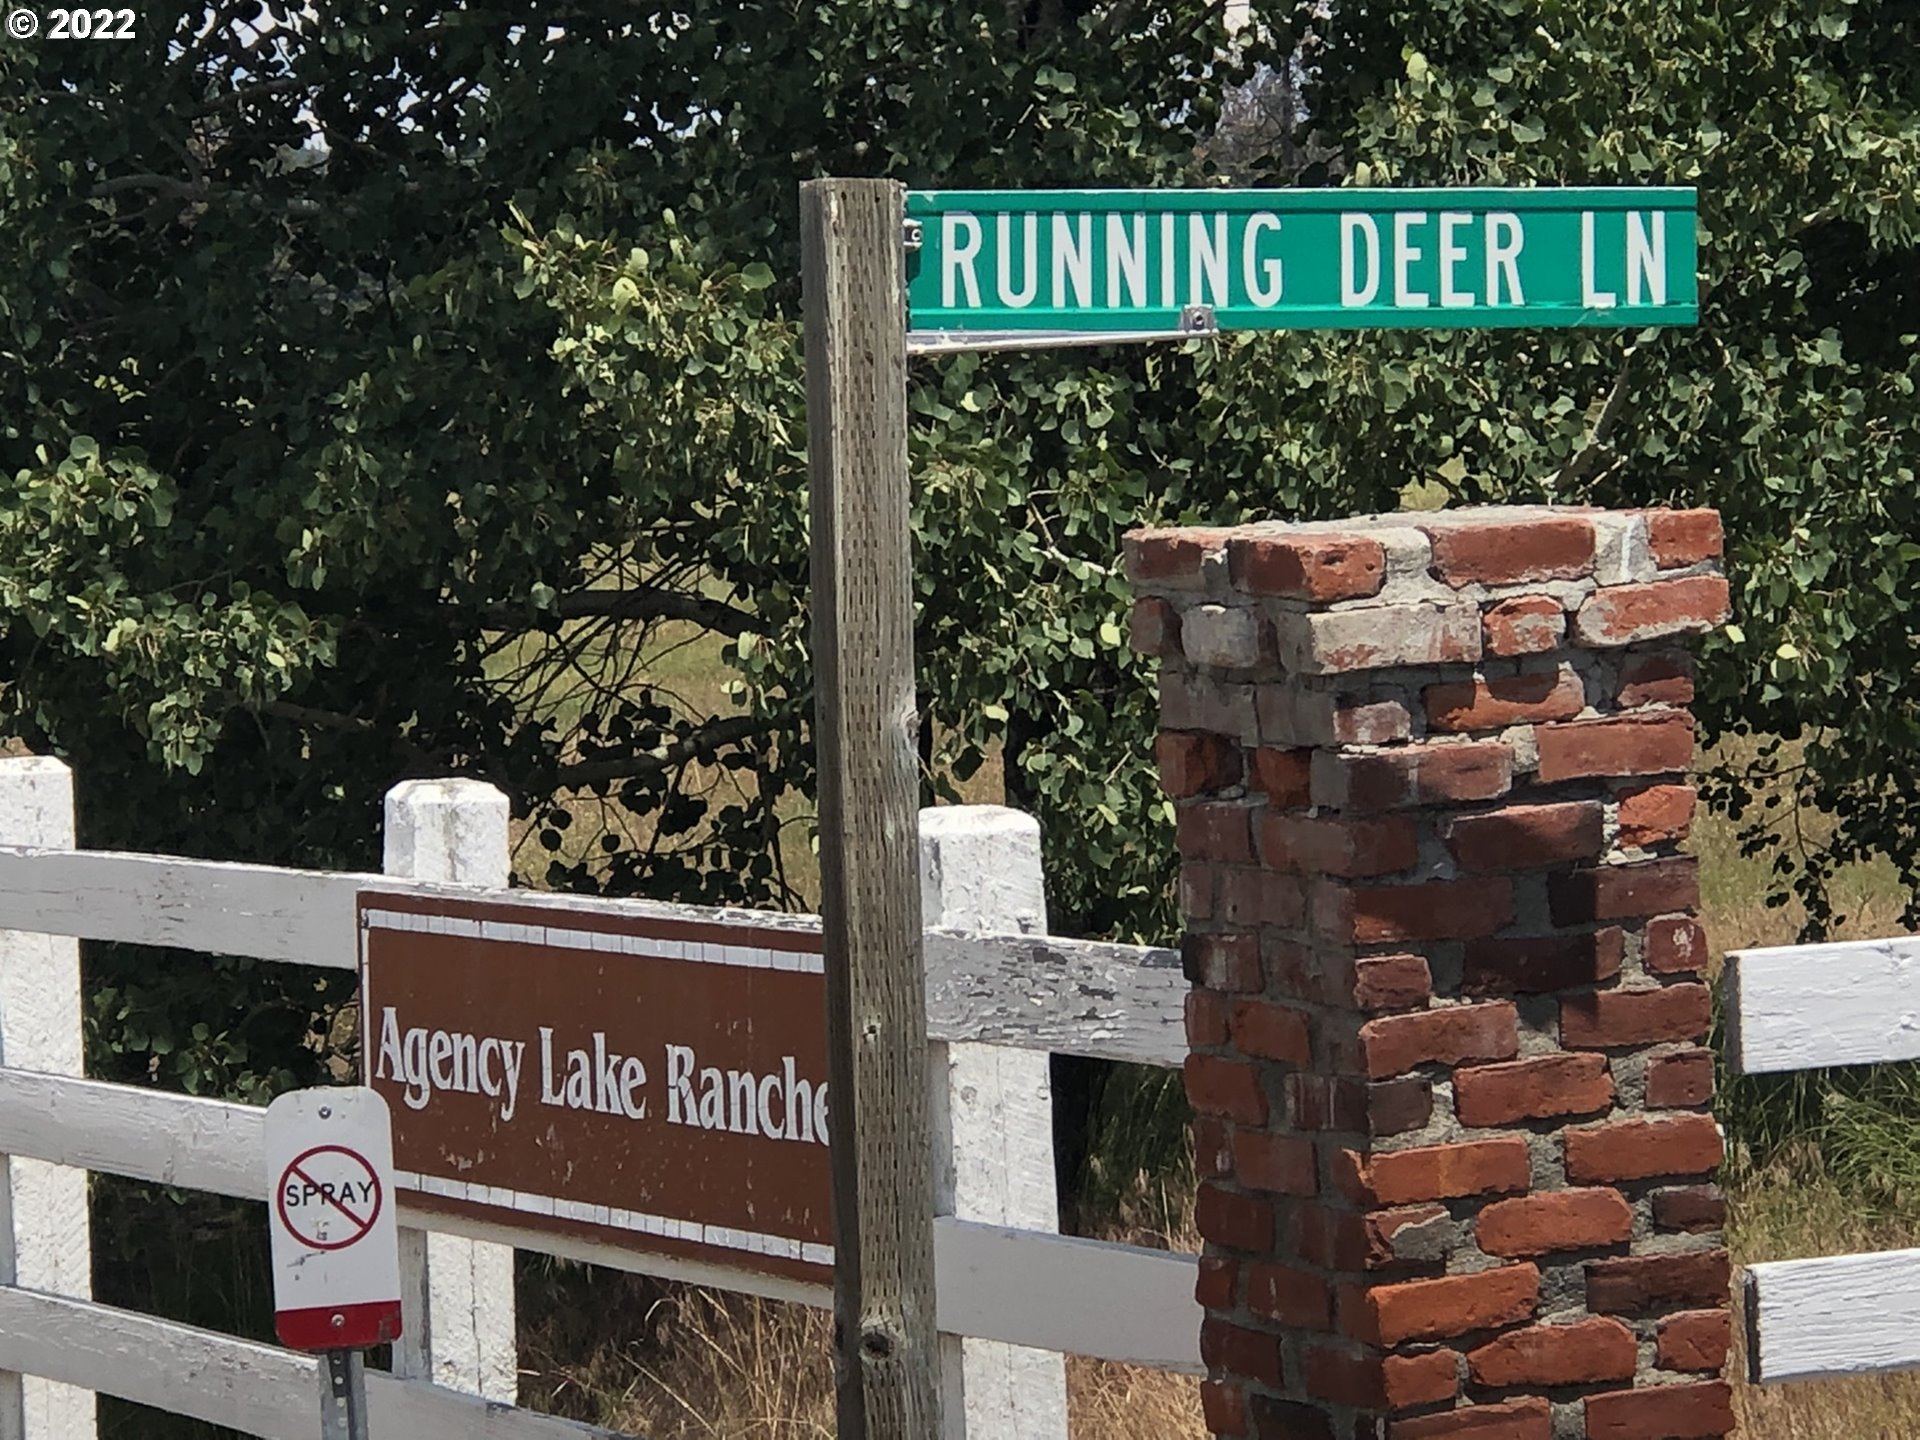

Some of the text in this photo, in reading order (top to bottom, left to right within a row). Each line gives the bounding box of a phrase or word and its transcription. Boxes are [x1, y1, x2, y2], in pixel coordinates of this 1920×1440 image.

[941, 209, 1666, 309] RUNNING DEER LN
[375, 1006, 526, 1122] Agency
[538, 1026, 647, 1120] Lake
[285, 1180, 374, 1207] SPRAY
